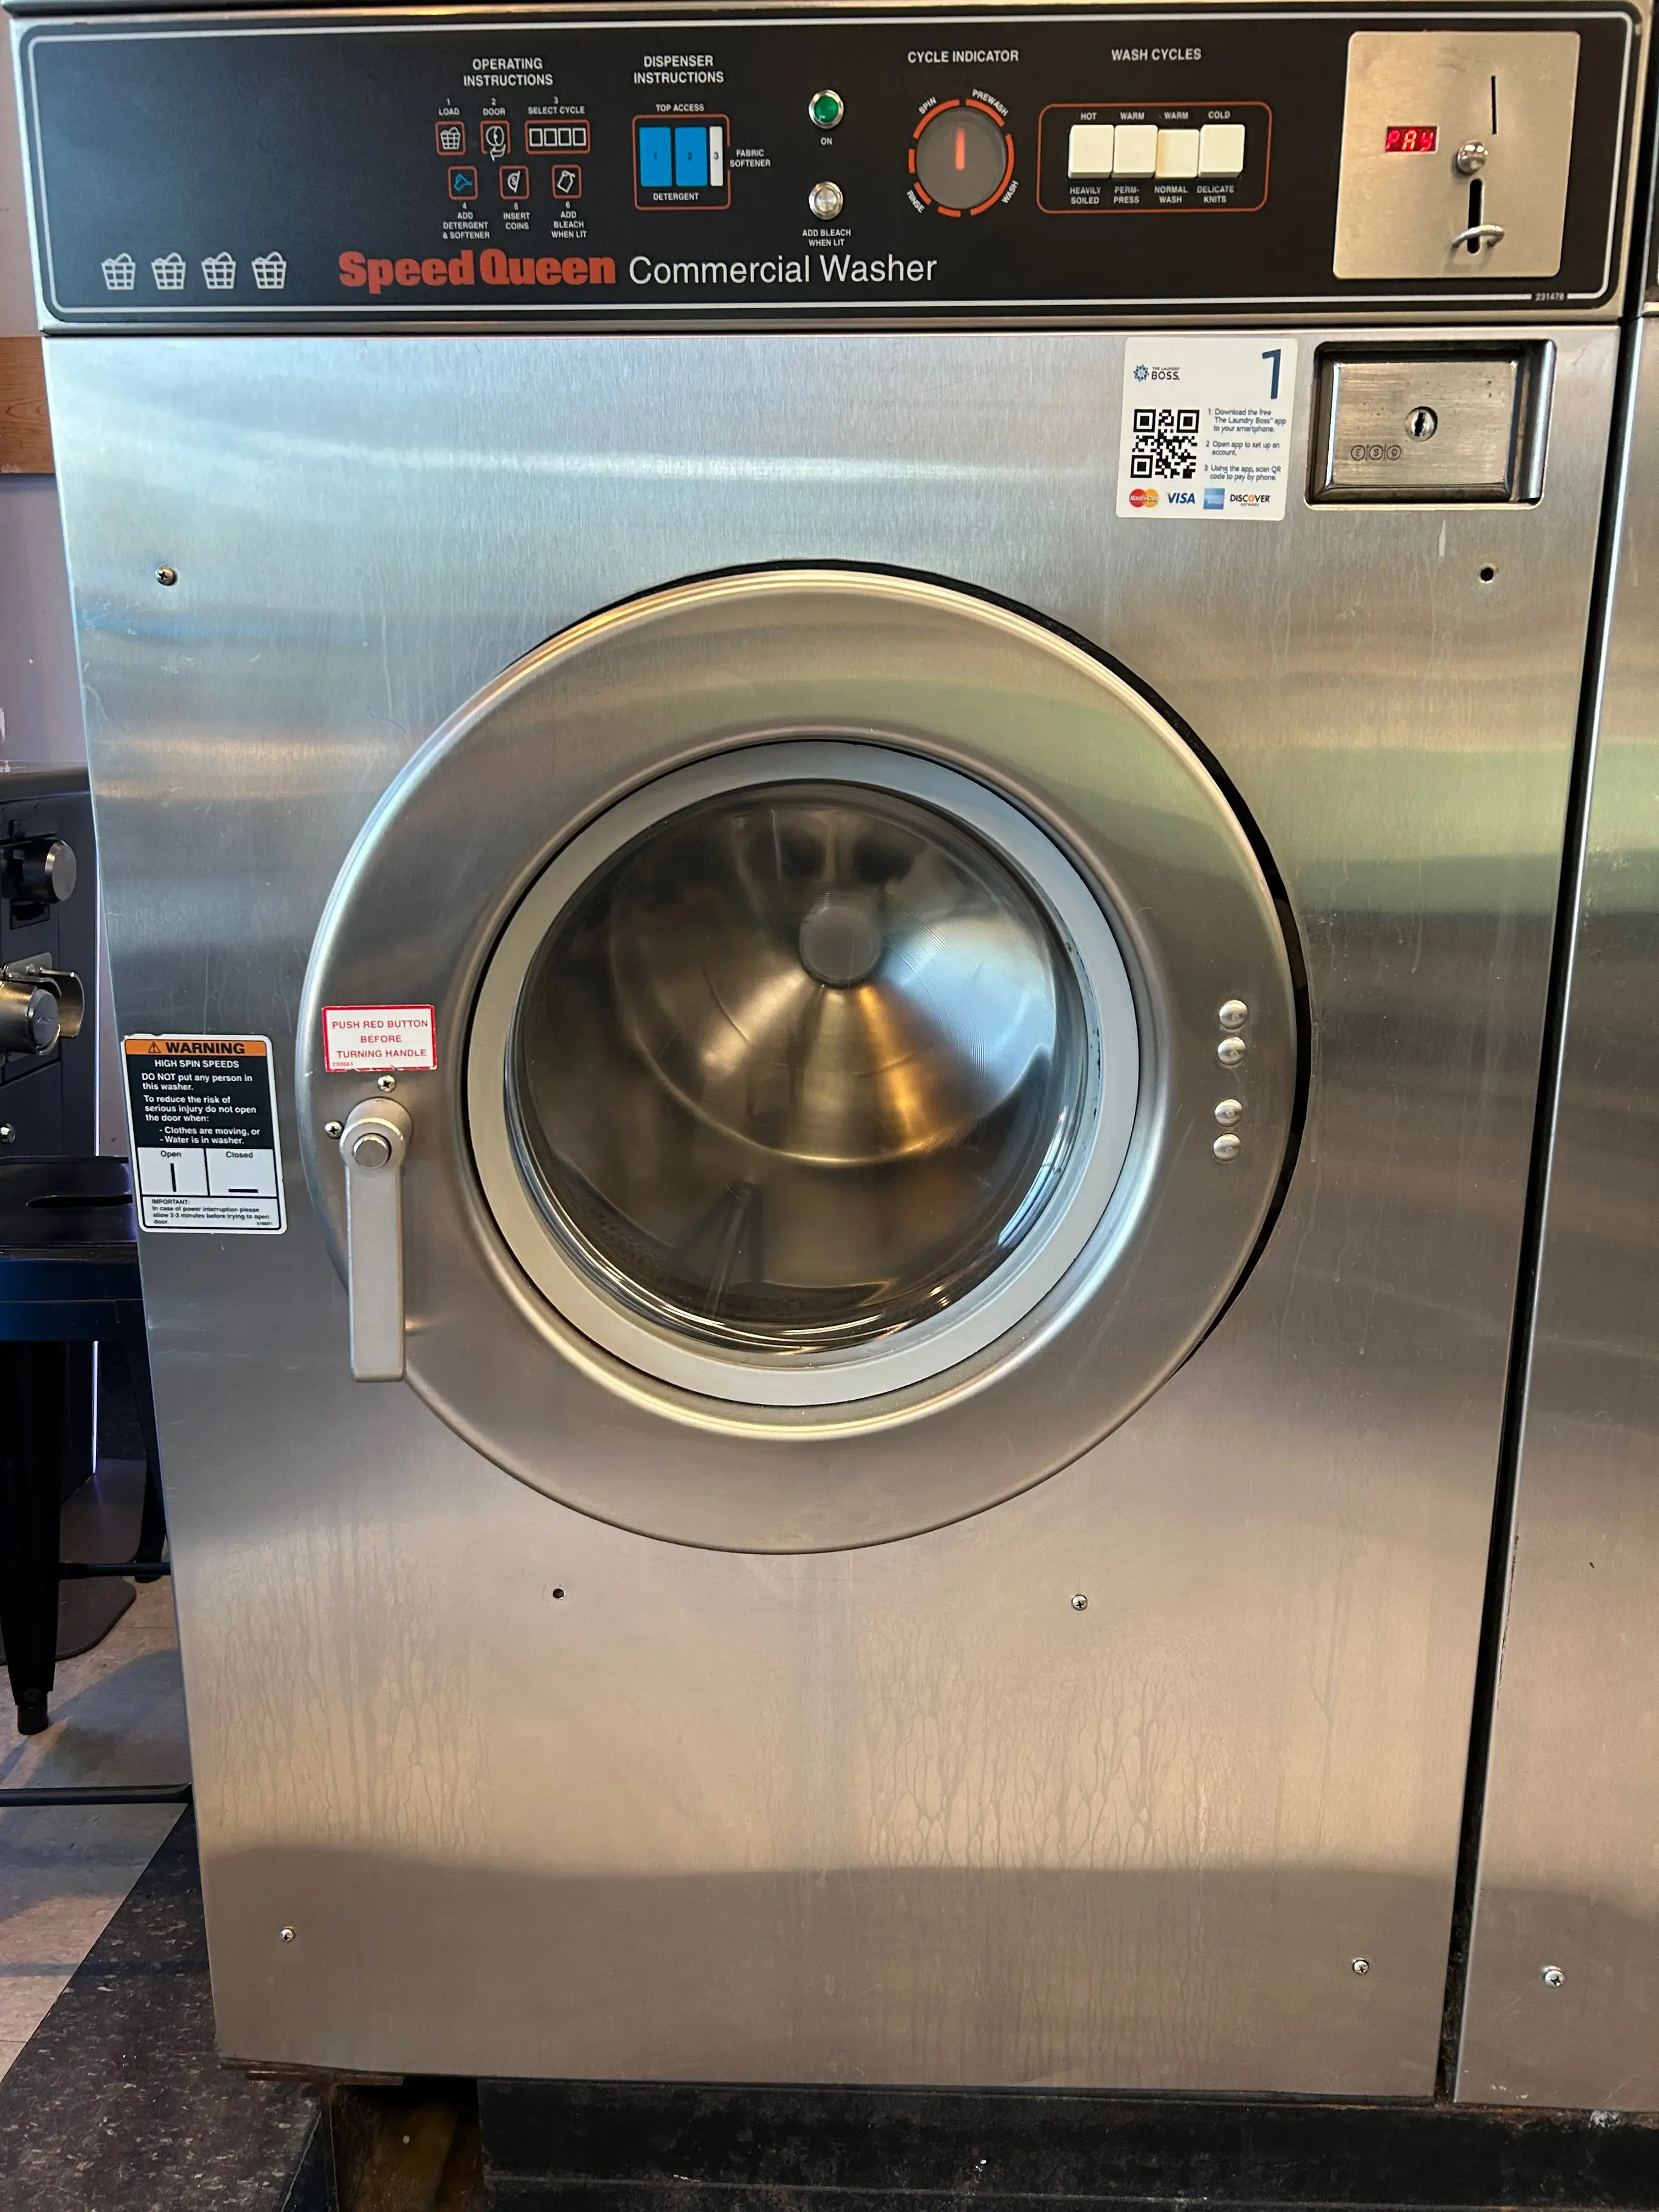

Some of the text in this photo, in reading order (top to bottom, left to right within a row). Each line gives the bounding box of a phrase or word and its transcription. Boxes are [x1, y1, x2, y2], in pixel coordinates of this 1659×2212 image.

[907, 49, 1019, 64] CYCLE INDICATOR
[1111, 48, 1202, 61] WASH CYCLES
[472, 57, 543, 70] OPERATING
[644, 55, 713, 68] DISPENSER
[464, 74, 553, 87] INSTRUCTIONS
[634, 71, 724, 84] INSTRUCTIONS
[446, 98, 450, 106] 1
[492, 98, 496, 106] 2
[918, 97, 937, 114] SPIN
[972, 88, 1009, 116] PREWASH
[439, 108, 460, 116] LOAD
[483, 108, 506, 116] DOOR
[528, 106, 585, 115] SELECT CYCLE
[656, 103, 704, 112] TOP ACCESS
[1080, 112, 1097, 120] HOT
[1120, 112, 1144, 120] WARM
[1164, 111, 1189, 120] WARM
[1208, 111, 1231, 119] COLD
[820, 137, 832, 145] ON
[1386, 130, 1434, 151] PAY
[687, 152, 692, 161] 2
[714, 151, 719, 160] 3
[736, 149, 764, 157] FABRIC
[730, 159, 771, 168] SOFTENER
[1001, 180, 1019, 204] WASH
[1070, 186, 1101, 194] HEAVILY
[1154, 185, 1188, 194] NORMAL
[1197, 185, 1234, 194] DELICATE
[653, 193, 699, 201] DETERGENT
[906, 190, 925, 213] RINSE
[1071, 196, 1099, 205] SOILED
[1113, 196, 1139, 204] PRESS
[1159, 196, 1182, 204] WASH
[1203, 195, 1227, 204] KNITS
[566, 201, 571, 209] 6
[503, 212, 531, 220] INSERT
[561, 211, 577, 219] ADD
[505, 222, 529, 230] COINS
[554, 221, 584, 229] BLEACH
[450, 231, 490, 239] SOFTENER
[802, 229, 851, 237] ADD BLEACH
[338, 248, 937, 294] Speed Queen Commercial Washer
[1262, 349, 1281, 399] 1
[1228, 417, 1254, 426] Laundry
[1237, 426, 1274, 434] smartphone.
[1212, 441, 1229, 449] Open
[1211, 465, 1228, 473] Using
[1271, 466, 1281, 474] QR
[1247, 473, 1255, 482] by
[1256, 473, 1276, 482] phone.
[1167, 493, 1195, 504] VISA
[1230, 494, 1270, 503] DISCOVER
[360, 1035, 402, 1043] BEFORE
[165, 1042, 245, 1054] WARNING
[337, 1049, 427, 1058] TURNING HANDLE
[179, 1060, 200, 1068] SPIN
[202, 1060, 240, 1069] SPEEDS
[178, 1074, 193, 1083] put
[156, 1095, 185, 1103] reduce
[178, 1105, 202, 1114] injury
[215, 1127, 249, 1136] moving,
[161, 1150, 182, 1159] Open
